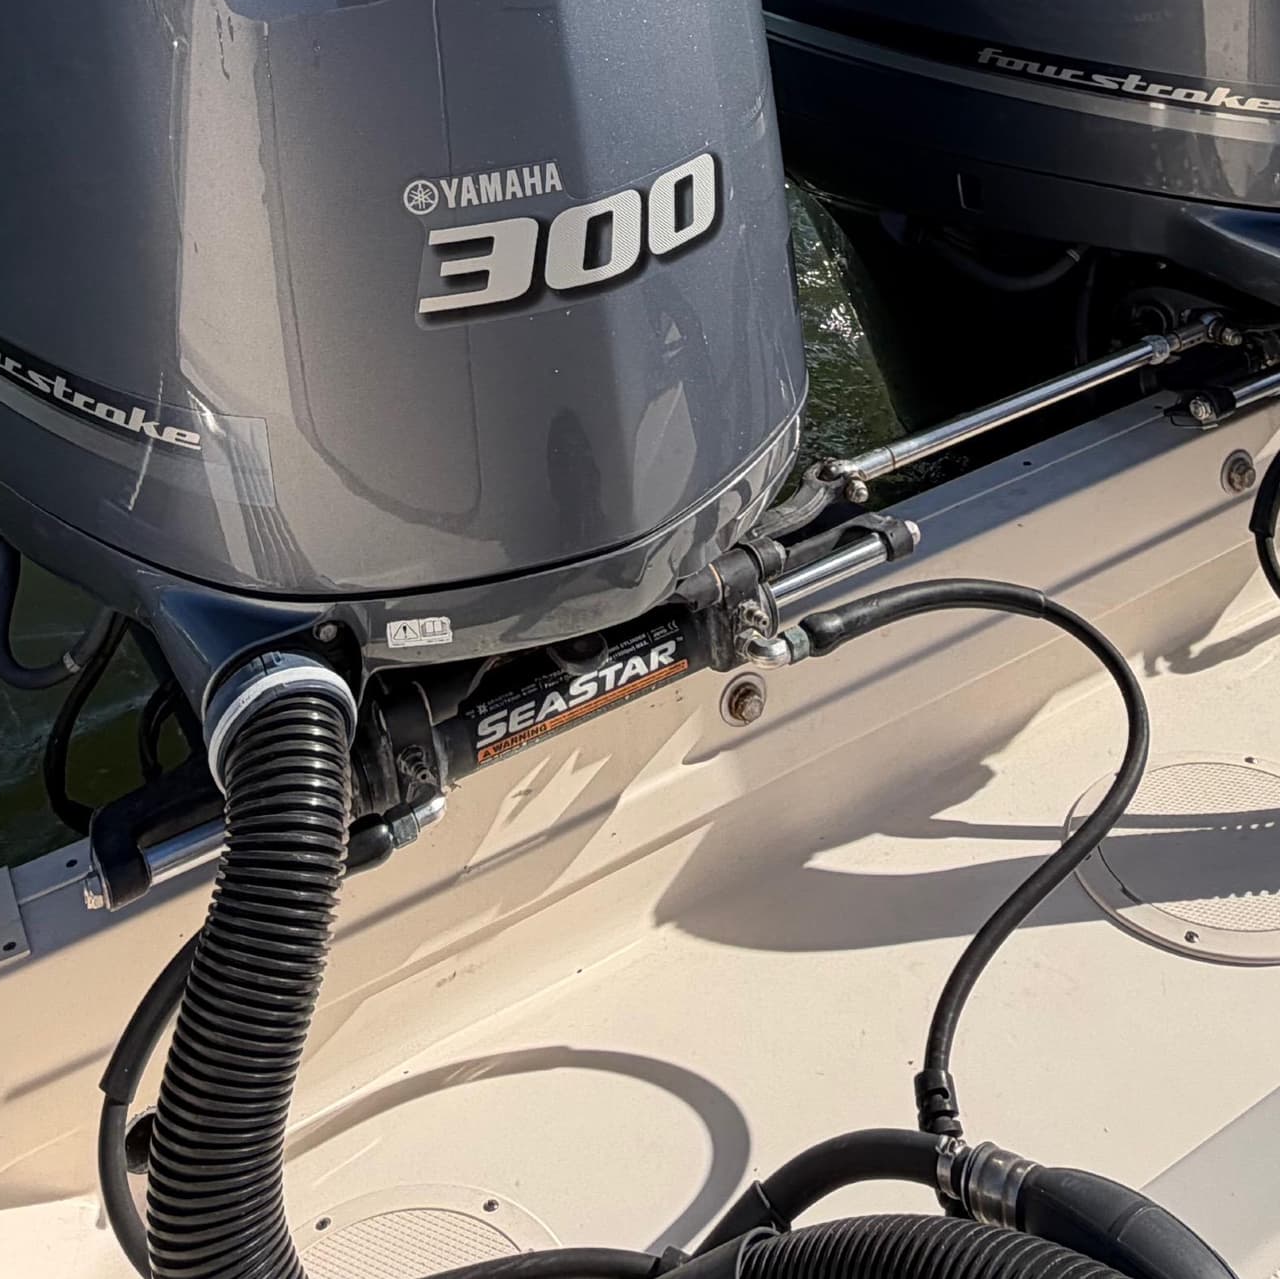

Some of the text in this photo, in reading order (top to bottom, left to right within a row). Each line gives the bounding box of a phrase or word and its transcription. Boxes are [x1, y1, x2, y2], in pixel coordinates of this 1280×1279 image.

[439, 162, 563, 209] YAMAHA
[419, 153, 716, 313] 300
[476, 639, 677, 749] SEASTAR
[492, 723, 548, 752] WARNING
